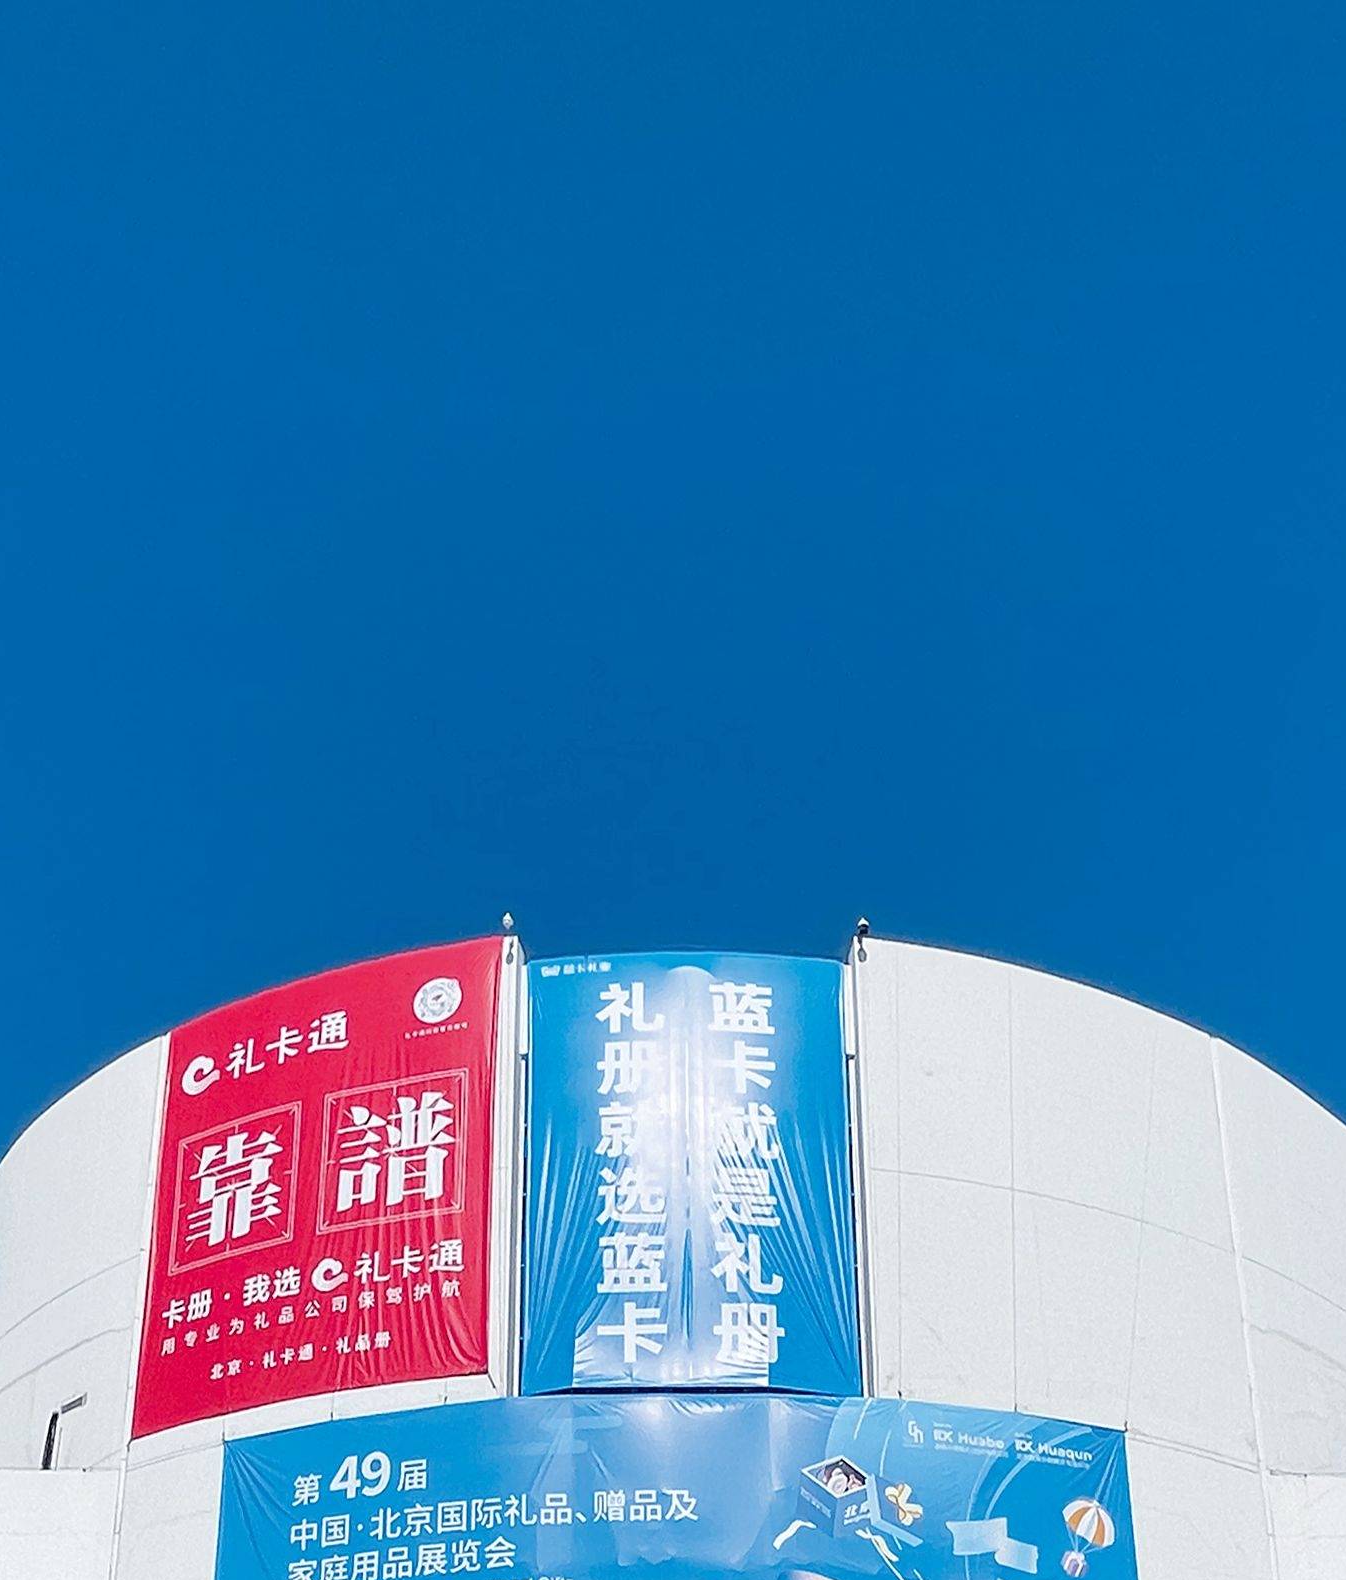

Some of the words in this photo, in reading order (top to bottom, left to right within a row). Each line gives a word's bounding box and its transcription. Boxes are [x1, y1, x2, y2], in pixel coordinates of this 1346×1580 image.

[225, 1010, 350, 1079] 礼卡通
[596, 982, 667, 1363] 礼册就选蓝卡
[708, 981, 785, 1364] 蓝卡就是礼册
[289, 1486, 699, 1554] 中国·北京国际礼品、赠品及
